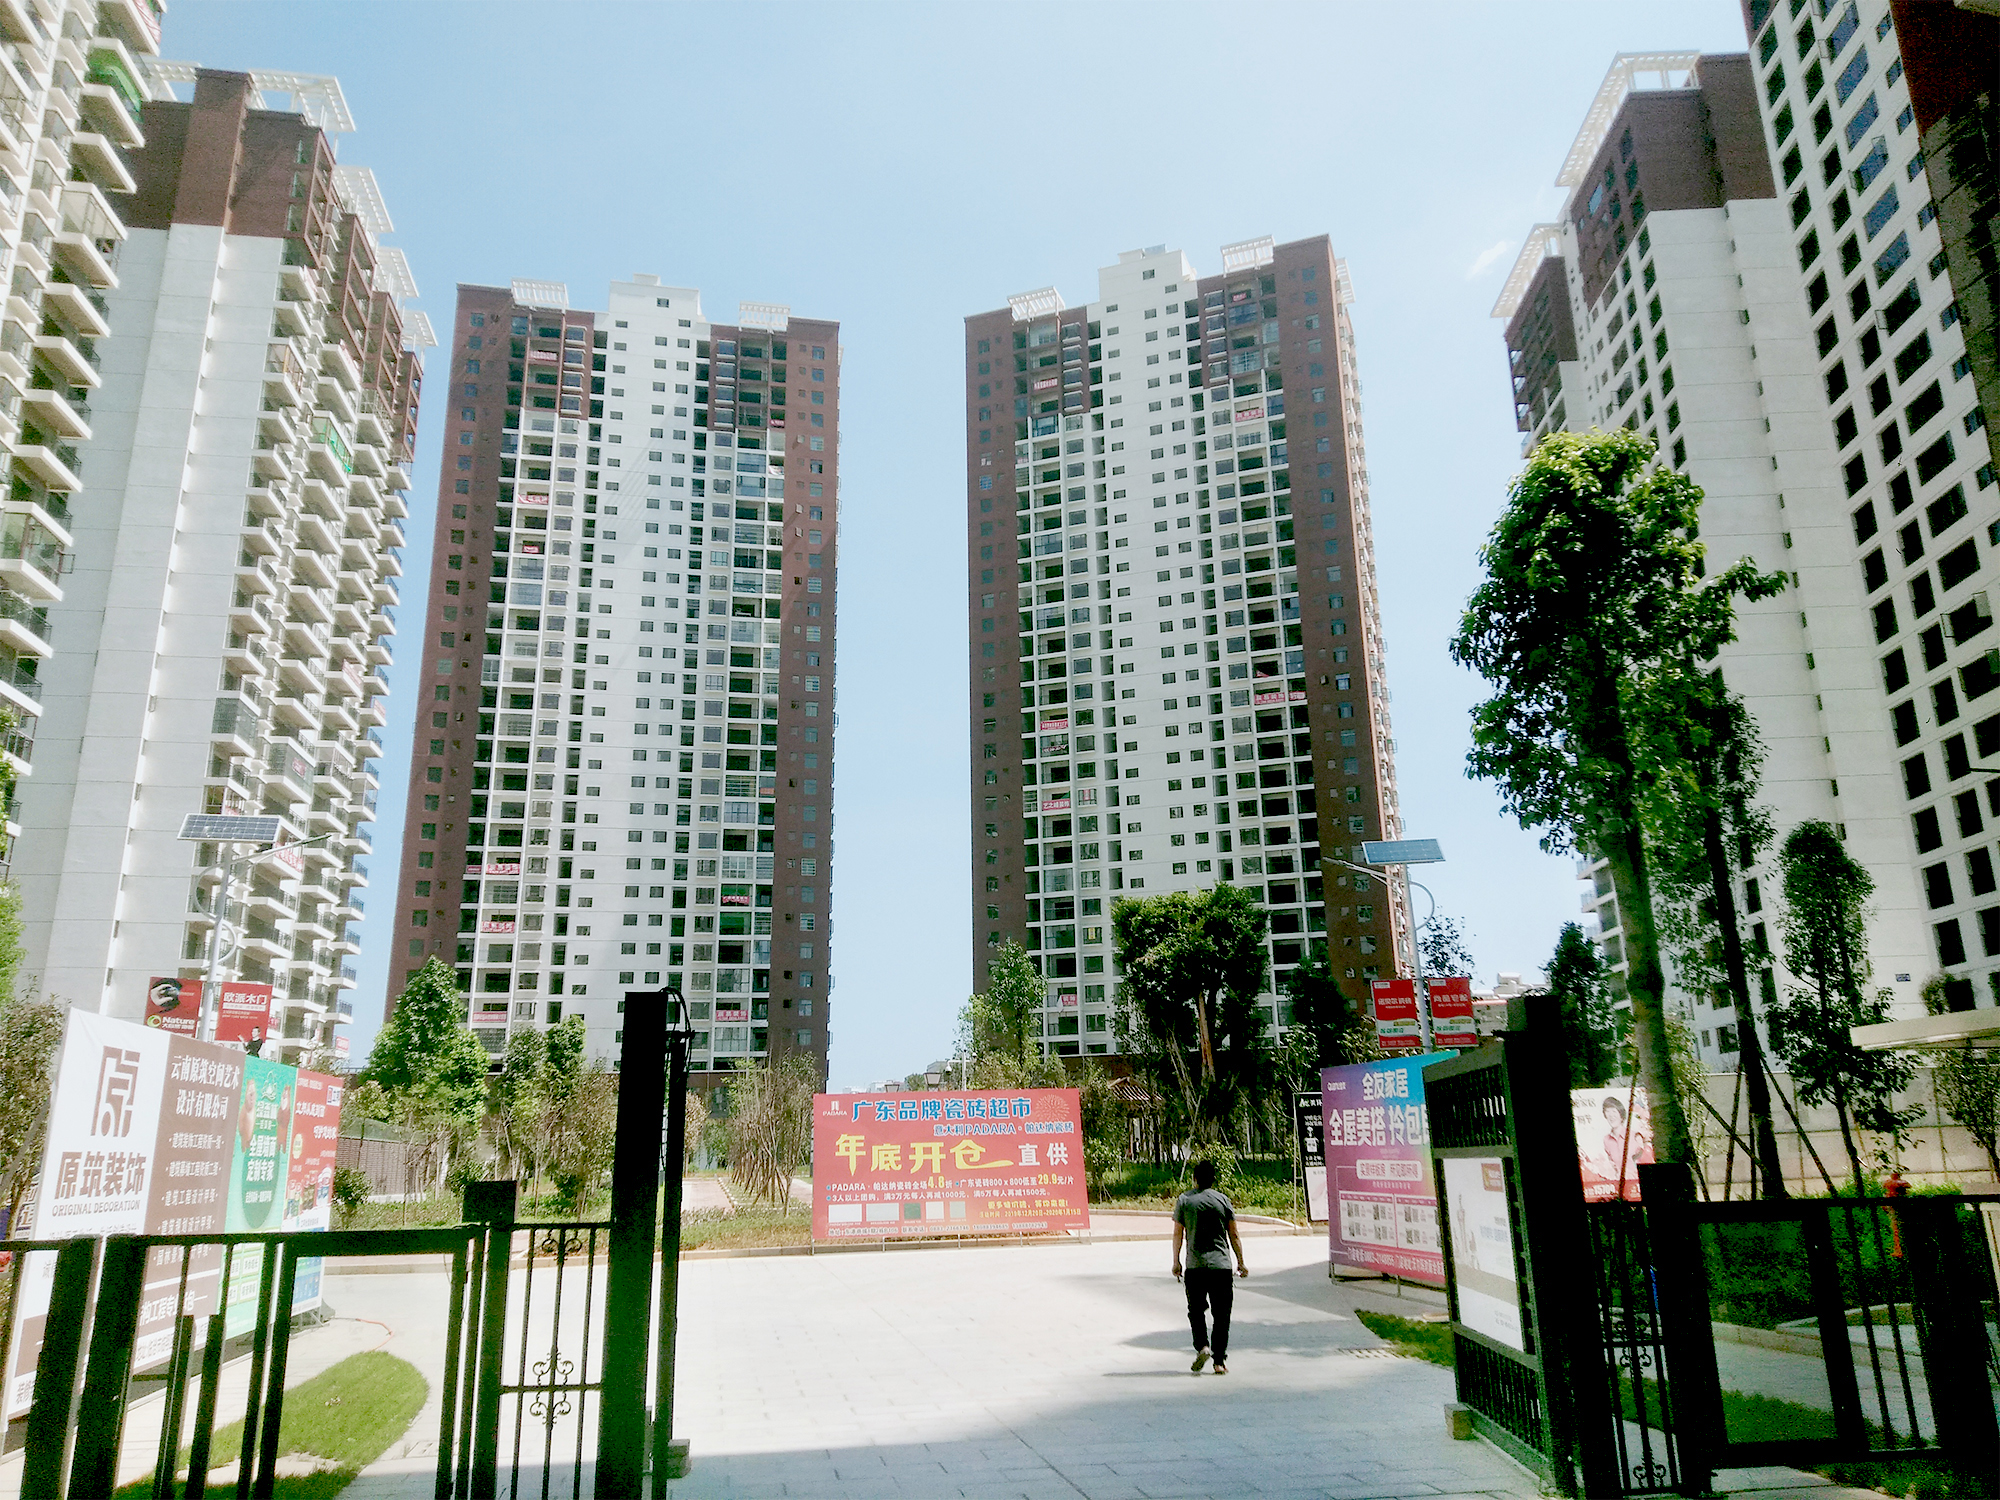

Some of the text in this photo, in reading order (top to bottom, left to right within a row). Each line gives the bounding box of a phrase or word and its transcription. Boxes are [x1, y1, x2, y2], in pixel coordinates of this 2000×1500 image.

[223, 992, 268, 1005] 欧派木门
[162, 1016, 195, 1025] Nature
[171, 1055, 240, 1090] 云南原筑空间艺术
[1362, 1068, 1409, 1101] 全友家居
[176, 1089, 229, 1120] 设计有限公司
[852, 1097, 1031, 1122] 广东品牌瓷砖超市
[835, 1134, 1069, 1176] 年底开仓 直供
[55, 1151, 147, 1200] 原筑装饰
[52, 1200, 140, 1217] ORIGINAL DECORATION
